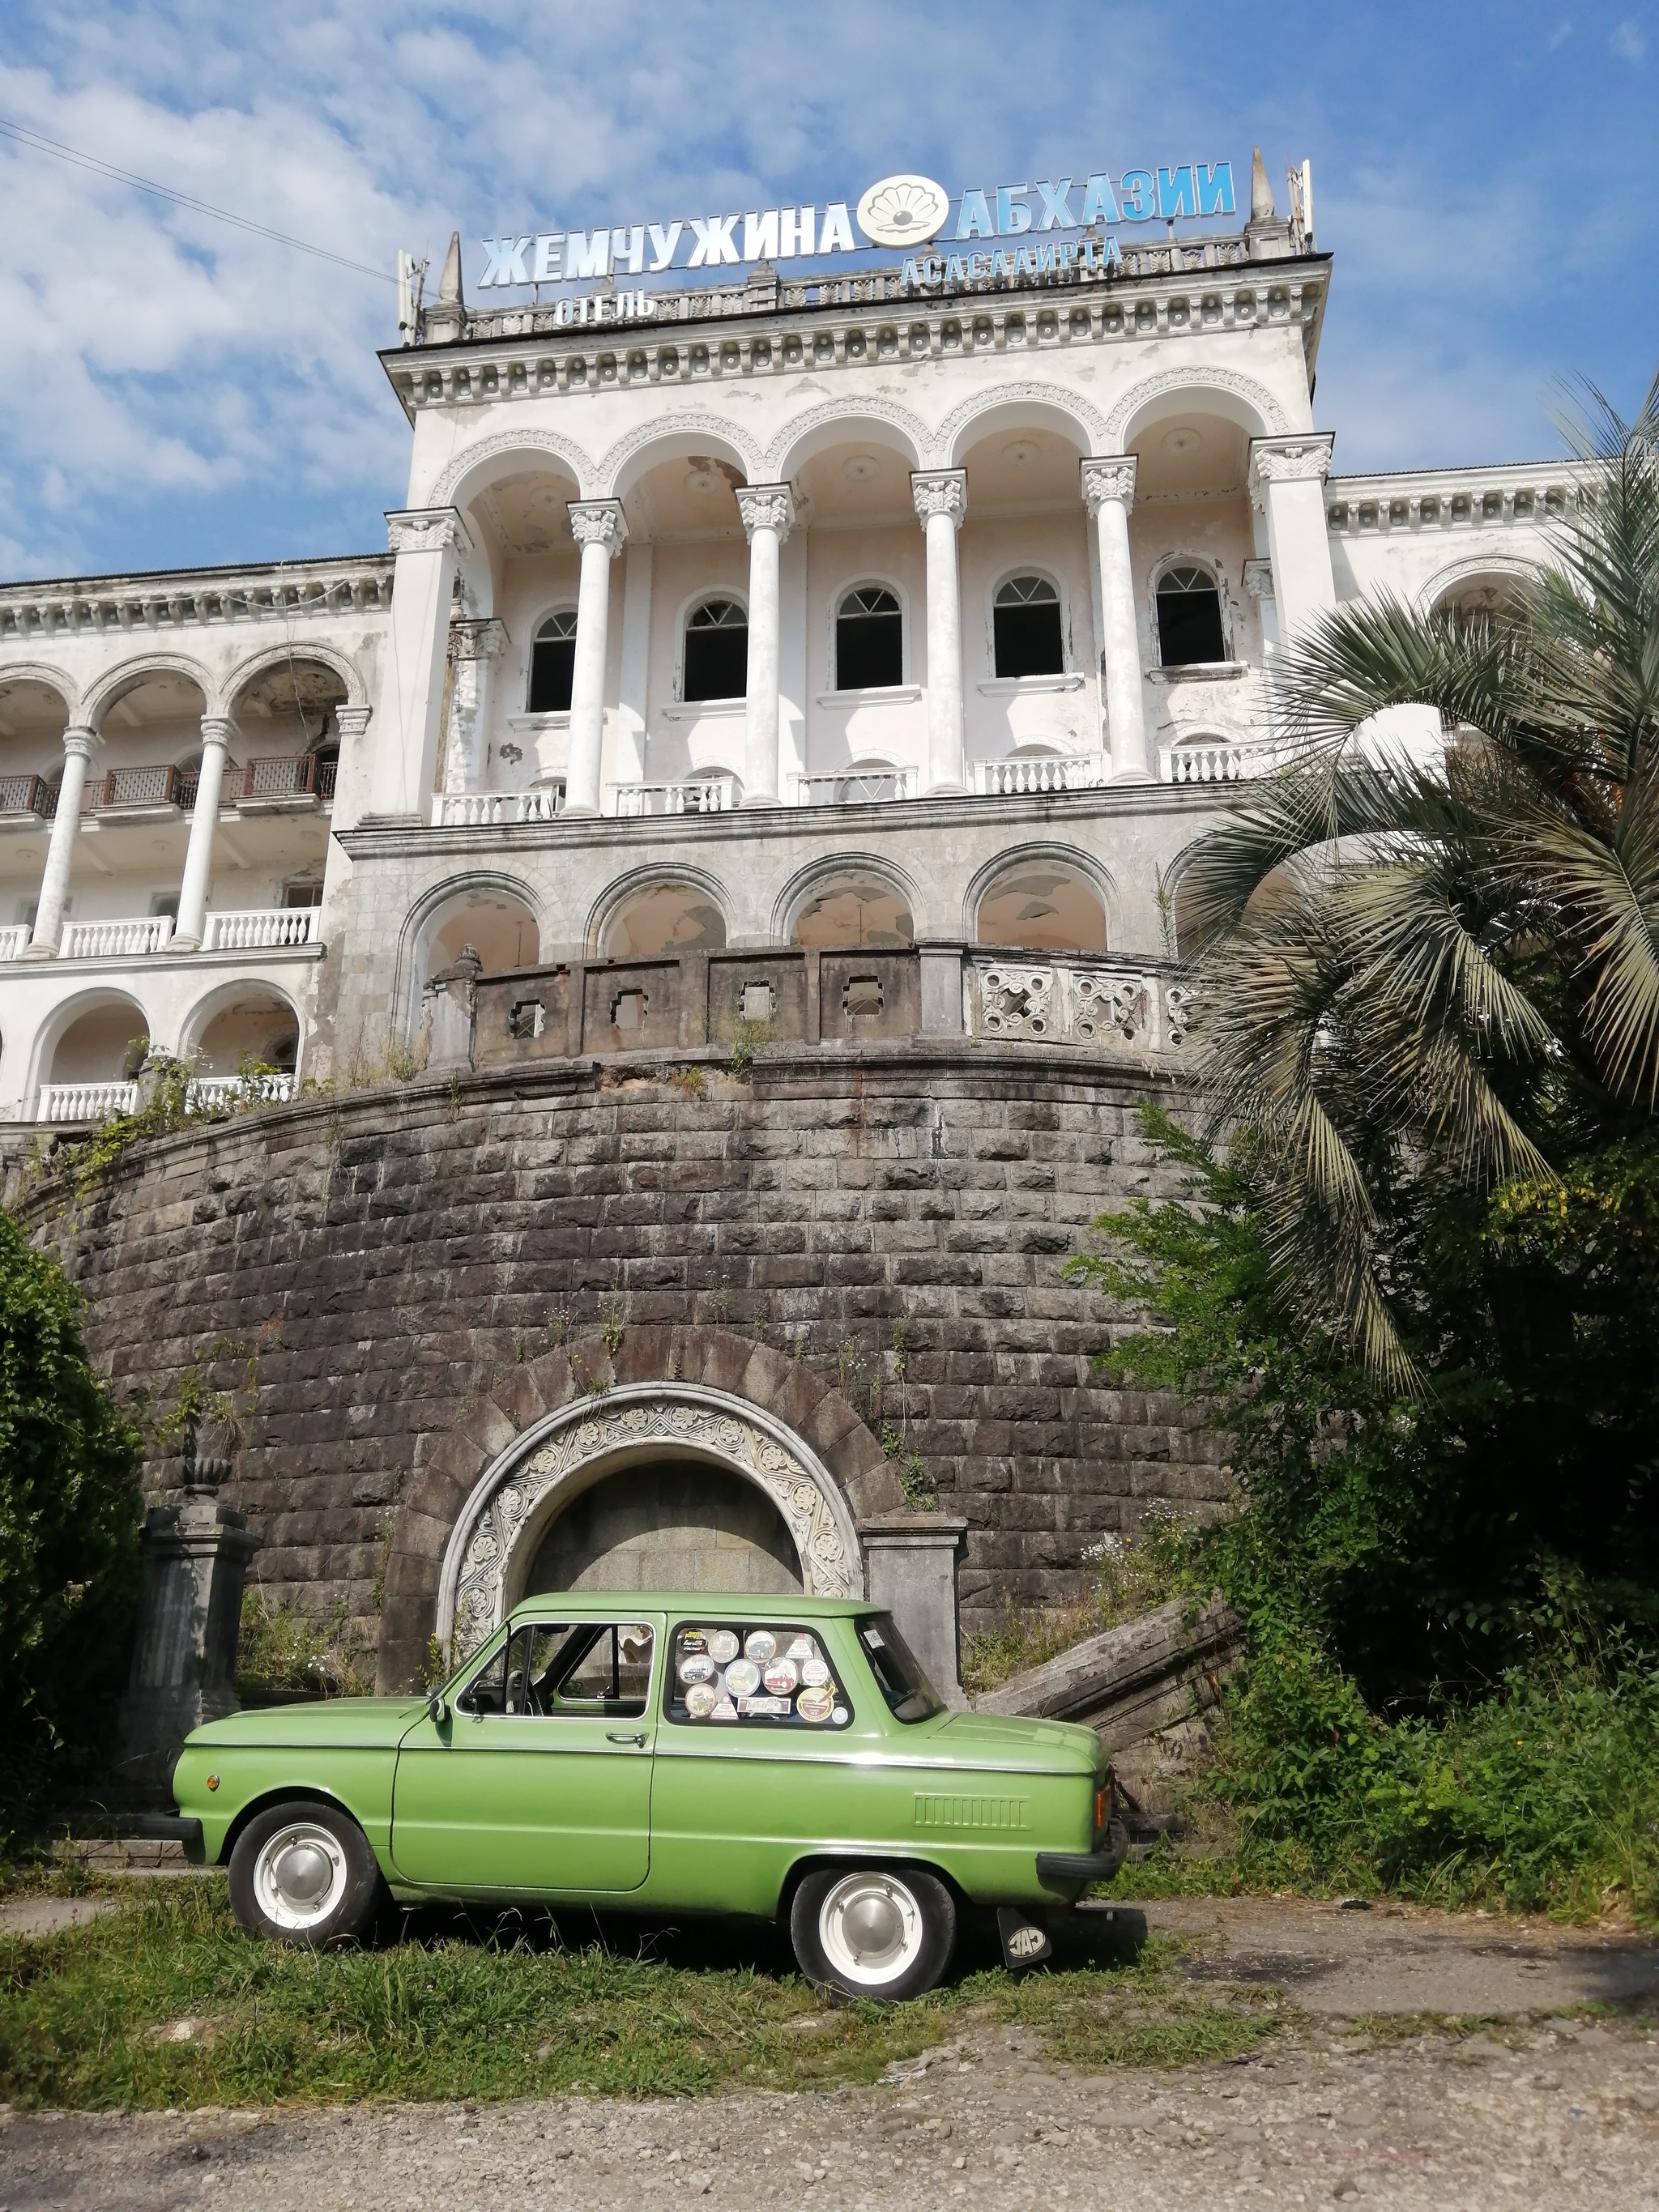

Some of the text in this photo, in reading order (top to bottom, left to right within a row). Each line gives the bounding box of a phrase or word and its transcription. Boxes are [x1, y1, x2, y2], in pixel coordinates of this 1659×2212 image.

[476, 161, 1236, 290] ЖЕМЧУЖИНА АБХАЗИИ
[555, 288, 658, 328] ОТЕЛЬ
[1009, 1929, 1044, 1955] ЗАЗ
